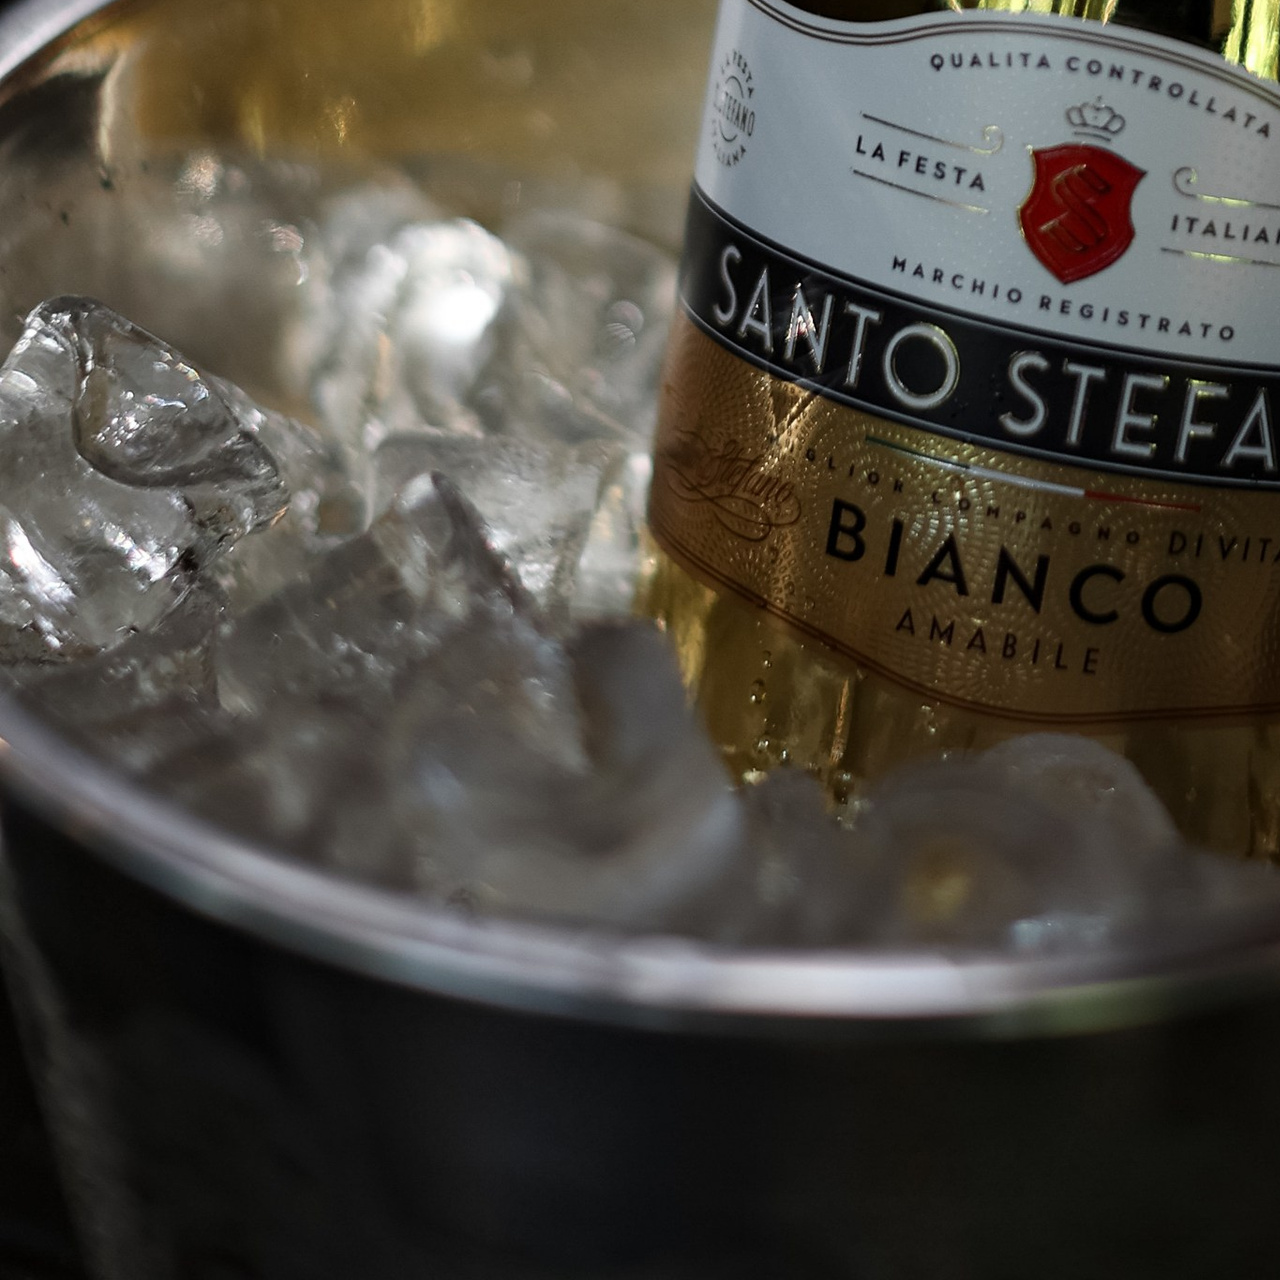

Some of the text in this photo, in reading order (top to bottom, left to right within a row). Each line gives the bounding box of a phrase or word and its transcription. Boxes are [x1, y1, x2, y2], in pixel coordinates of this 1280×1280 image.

[930, 52, 1273, 139] QUALITA CONTROLLATA
[855, 135, 986, 192] LA FESTA
[713, 244, 961, 410] SANTO
[892, 254, 1236, 341] MARCHIO REGISTRATO
[824, 497, 1203, 634] BIANCO
[931, 489, 1141, 546] COMPAGNO
[1168, 531, 1203, 559] DI
[895, 607, 1101, 676] AMABILE
